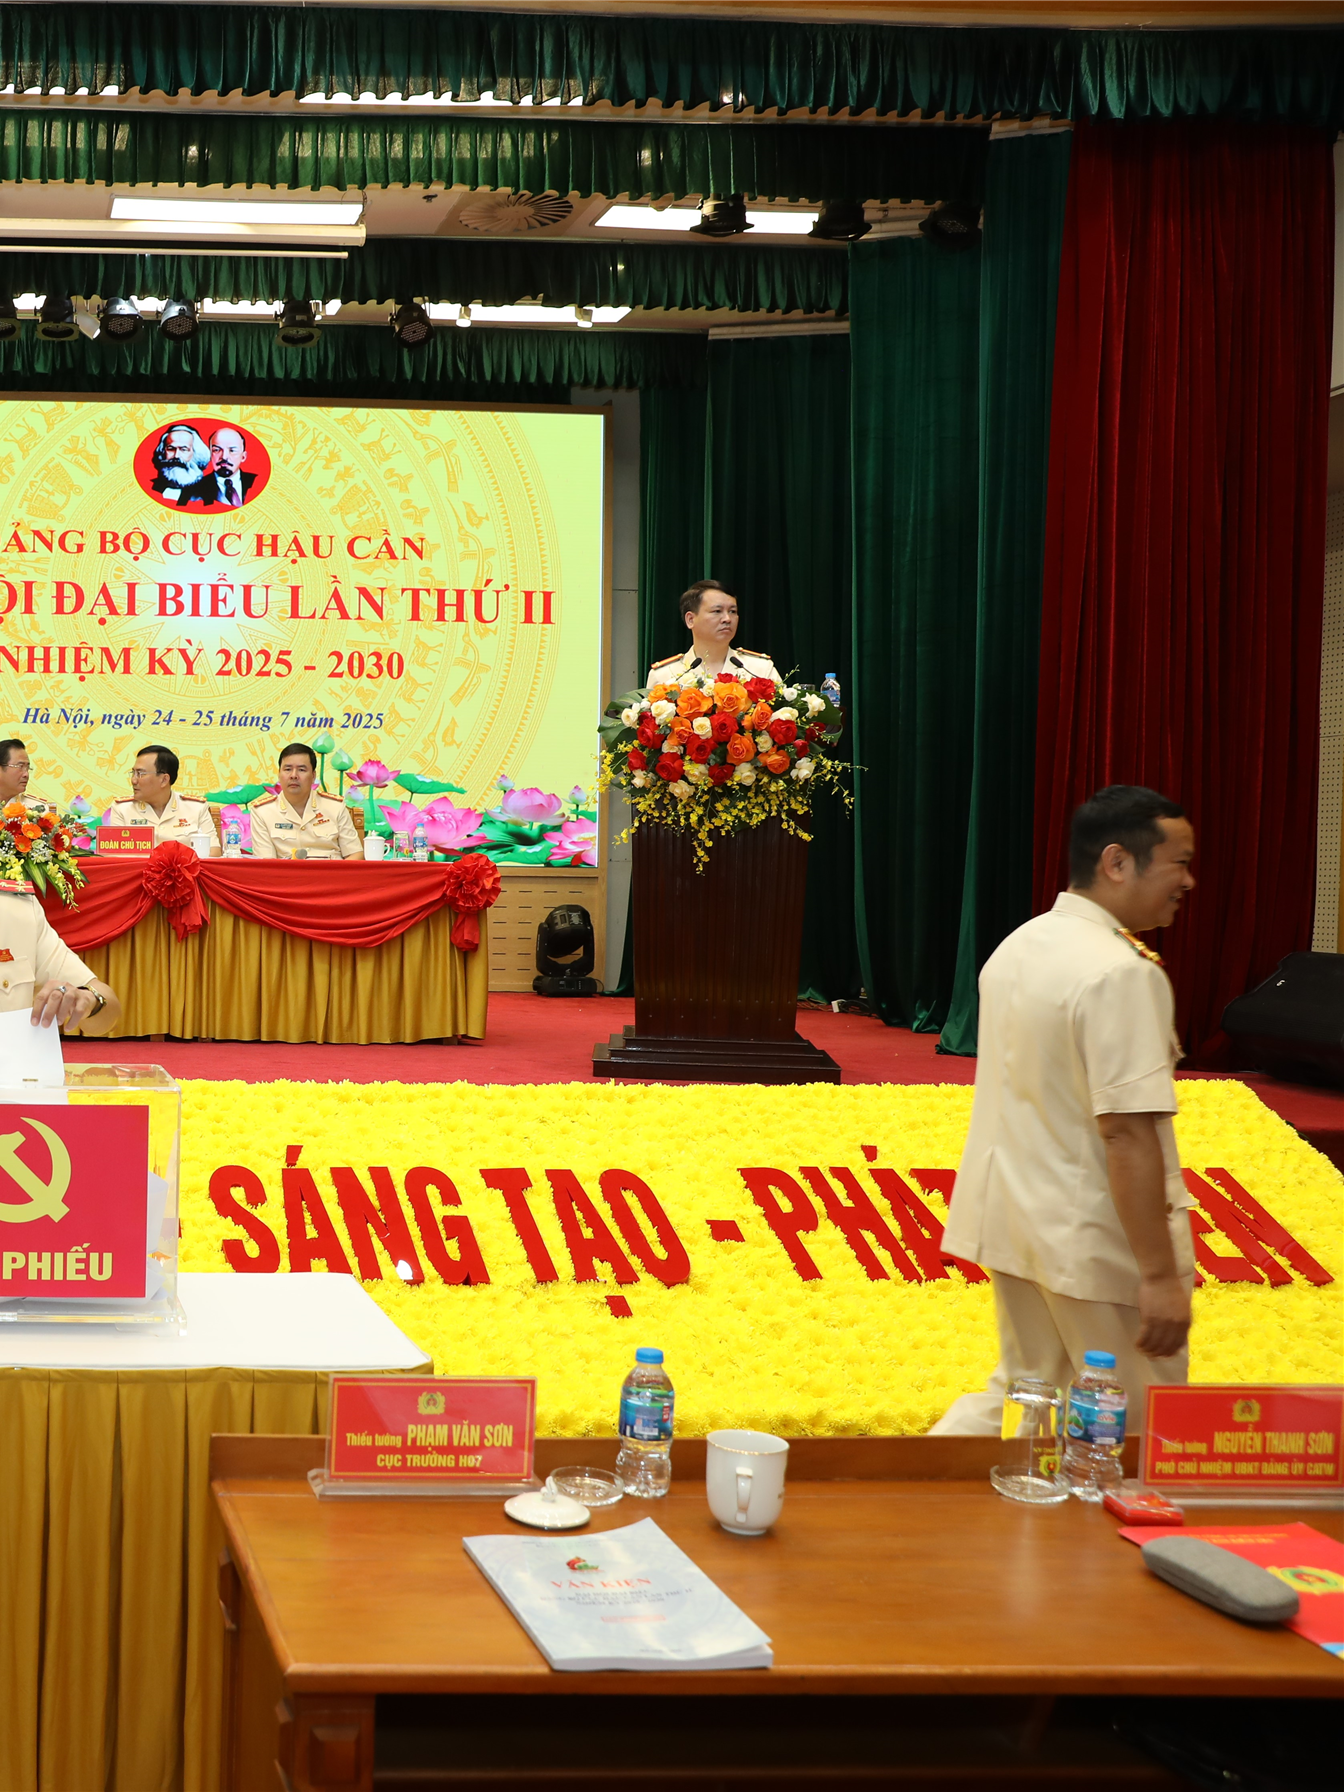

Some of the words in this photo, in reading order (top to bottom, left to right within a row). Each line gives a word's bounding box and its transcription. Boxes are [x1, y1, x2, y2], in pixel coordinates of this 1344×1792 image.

[97, 527, 151, 562] BỘ
[162, 531, 242, 563] CỤC
[253, 530, 336, 565] HẬU
[346, 529, 426, 561] CẦN
[51, 580, 141, 626] ĐẠI
[156, 572, 273, 620] BIỂU
[286, 574, 387, 622] LẦN
[401, 578, 510, 624] THỨ
[519, 590, 556, 625] II
[145, 638, 204, 677] KỲ
[215, 648, 293, 678] 2025
[327, 650, 405, 680] 2030
[22, 707, 51, 724] Hà
[56, 708, 94, 729] Nội,
[101, 709, 146, 730] ngày
[151, 709, 174, 726] 24
[192, 710, 214, 727] 25
[219, 710, 273, 732] tháng
[280, 711, 291, 728] 7
[294, 712, 334, 728] năm
[340, 712, 384, 729] 2025
[120, 838, 135, 850] CHỦ
[136, 840, 152, 851] TỊCH
[209, 1145, 491, 1285] SÁNG
[479, 1168, 692, 1318] TẠO
[737, 1145, 990, 1285] PHÁ
[2, 1242, 113, 1281] PHIẾU
[346, 1430, 372, 1446] Thiếu
[374, 1432, 402, 1448] tướng
[407, 1423, 448, 1451] PHẠM
[452, 1419, 480, 1447] VĂN
[484, 1422, 514, 1447] SƠN
[1265, 1431, 1306, 1454] THANH
[1307, 1430, 1334, 1455] SƠN
[376, 1454, 402, 1470] CỤC
[406, 1450, 455, 1467] TRƯỞNG
[1156, 1459, 1175, 1474] PHÓ
[1199, 1459, 1232, 1477] NHIỆM
[1234, 1461, 1260, 1474] UBKT
